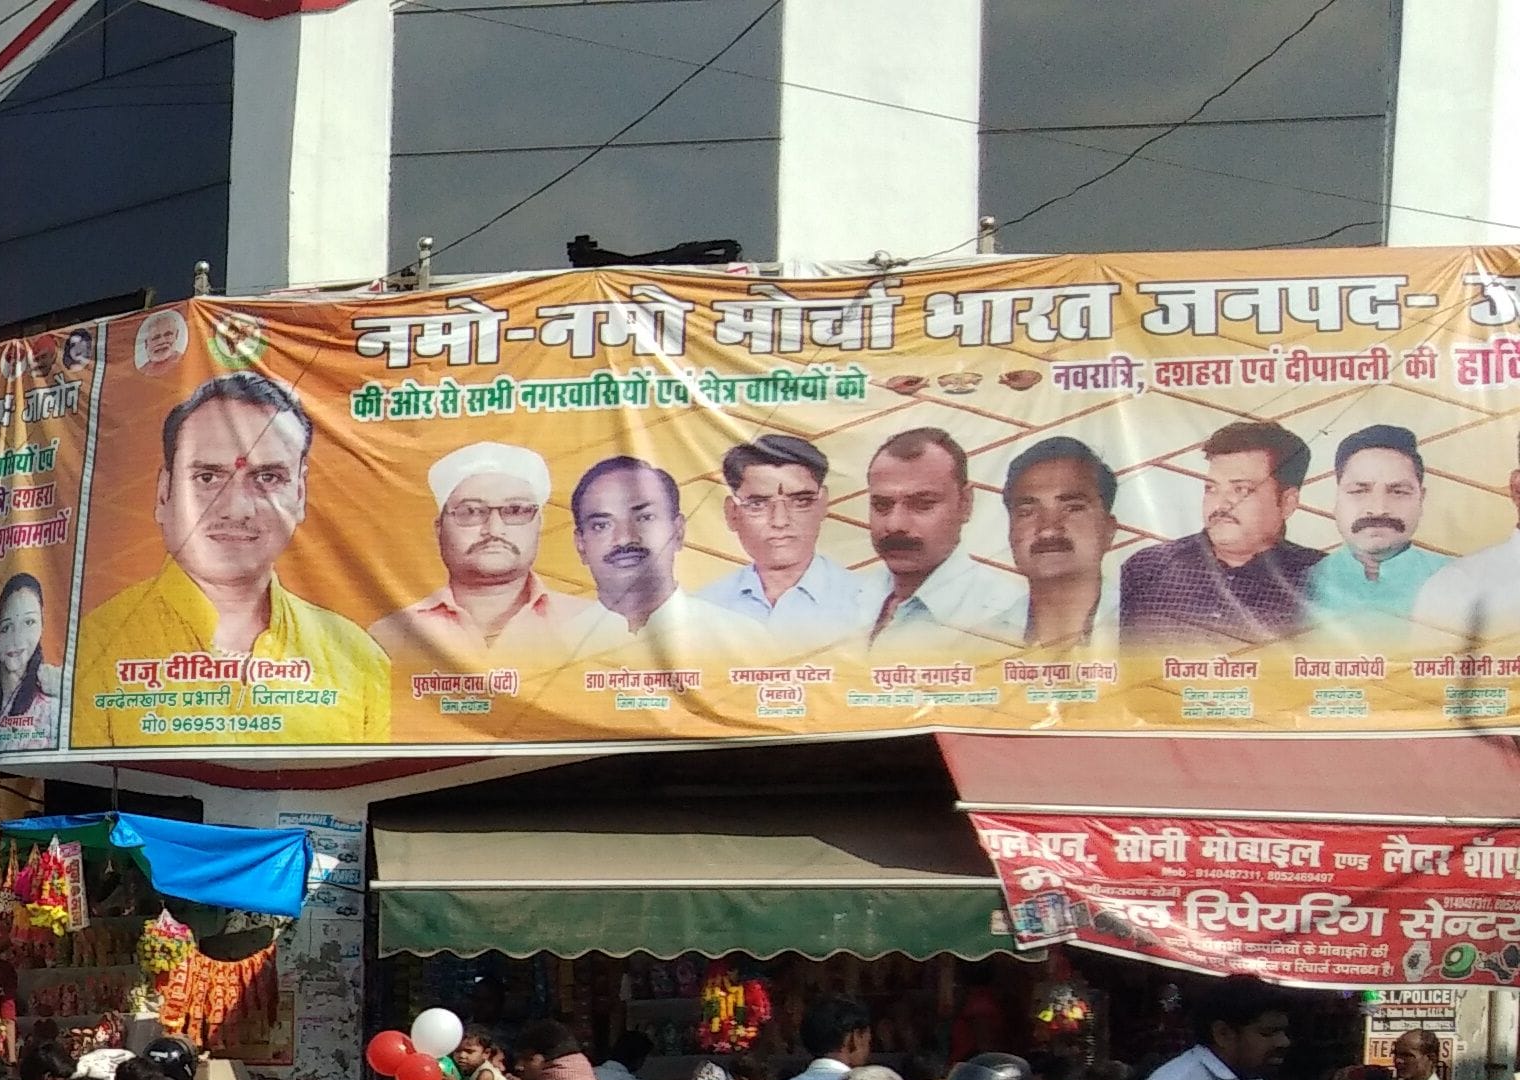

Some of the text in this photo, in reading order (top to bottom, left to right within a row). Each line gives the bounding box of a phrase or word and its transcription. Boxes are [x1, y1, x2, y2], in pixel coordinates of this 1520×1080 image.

[352, 284, 694, 369] नमो-नमो
[713, 278, 903, 357] मोर्चा
[922, 282, 1122, 347] भारत
[1053, 347, 1439, 394] नवरात्रि, दशहरा एवं दीपावली की
[352, 383, 386, 419] की
[389, 376, 436, 416] ओर
[439, 377, 462, 414] से
[466, 378, 514, 414] सभी
[520, 368, 652, 410] नगरवासियों
[658, 370, 694, 408] एवं
[836, 365, 866, 400] को
[12, 483, 55, 510] दशहरा
[119, 661, 160, 688] राजू
[166, 655, 242, 681] दीक्षित
[796, 667, 832, 683] पटेल
[873, 664, 916, 690] रघुवीर
[1004, 662, 1039, 682] विवेक
[1165, 656, 1258, 678] विजय चौहान
[1294, 654, 1385, 677] विजय वाजपेयी
[1413, 654, 1492, 678] रामजी सोनी
[463, 672, 485, 692] दास
[608, 670, 641, 690] मनोज
[642, 672, 675, 696] कुमार
[675, 670, 701, 696] गुप्ता
[182, 686, 232, 707] प्रभारी
[251, 684, 337, 707] जिलाध्यक्ष
[172, 717, 282, 733] 9695319485
[1114, 827, 1191, 864] सोनी
[1200, 831, 1325, 868] मोबाइल
[1333, 853, 1371, 872] एण्ड
[1184, 888, 1389, 938] रिपेयरिंग
